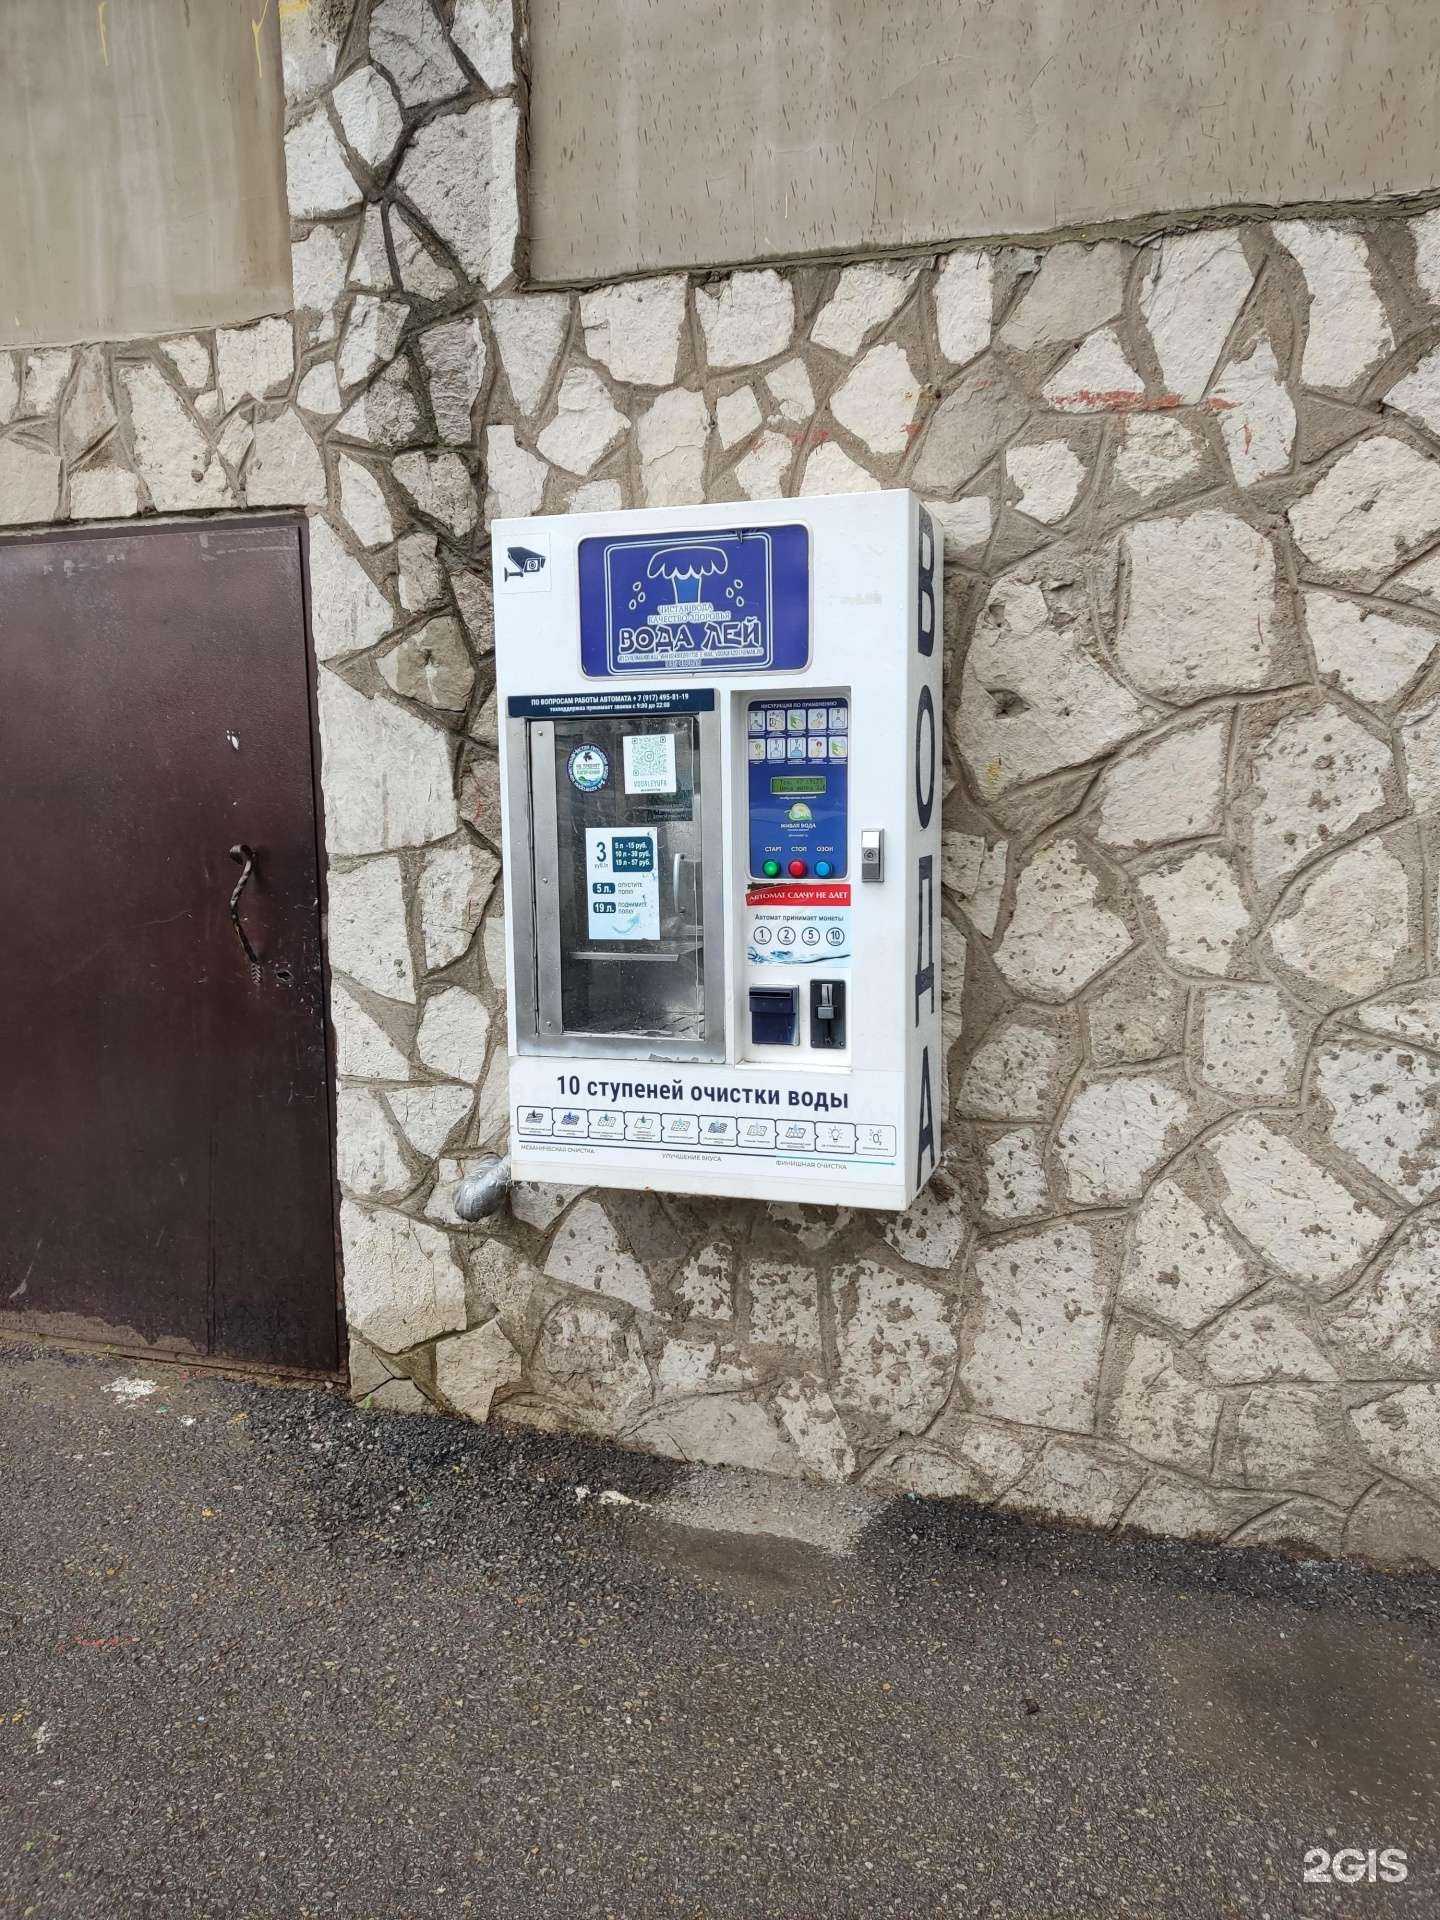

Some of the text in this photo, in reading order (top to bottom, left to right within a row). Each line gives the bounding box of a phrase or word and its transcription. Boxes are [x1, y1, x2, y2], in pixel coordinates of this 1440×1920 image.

[619, 616, 762, 653] ВОДА ЛЕЙ
[541, 697, 573, 706] ВОПРОСАМ
[574, 696, 599, 704] РАБОТЫ
[600, 694, 632, 703] АВТОМАТА
[596, 842, 607, 862] 3
[915, 503, 937, 1191] ВОДА
[596, 885, 602, 893] 5
[749, 891, 848, 901] АВТОМАТ СДАЧУ НЕ ДАЕТ
[594, 903, 604, 912] 19
[754, 913, 781, 921] Автомат
[830, 930, 840, 940] 10
[557, 1075, 849, 1112] 10 ступеней очистки воды
[775, 1160, 815, 1168] ФИНИШНАЯ
